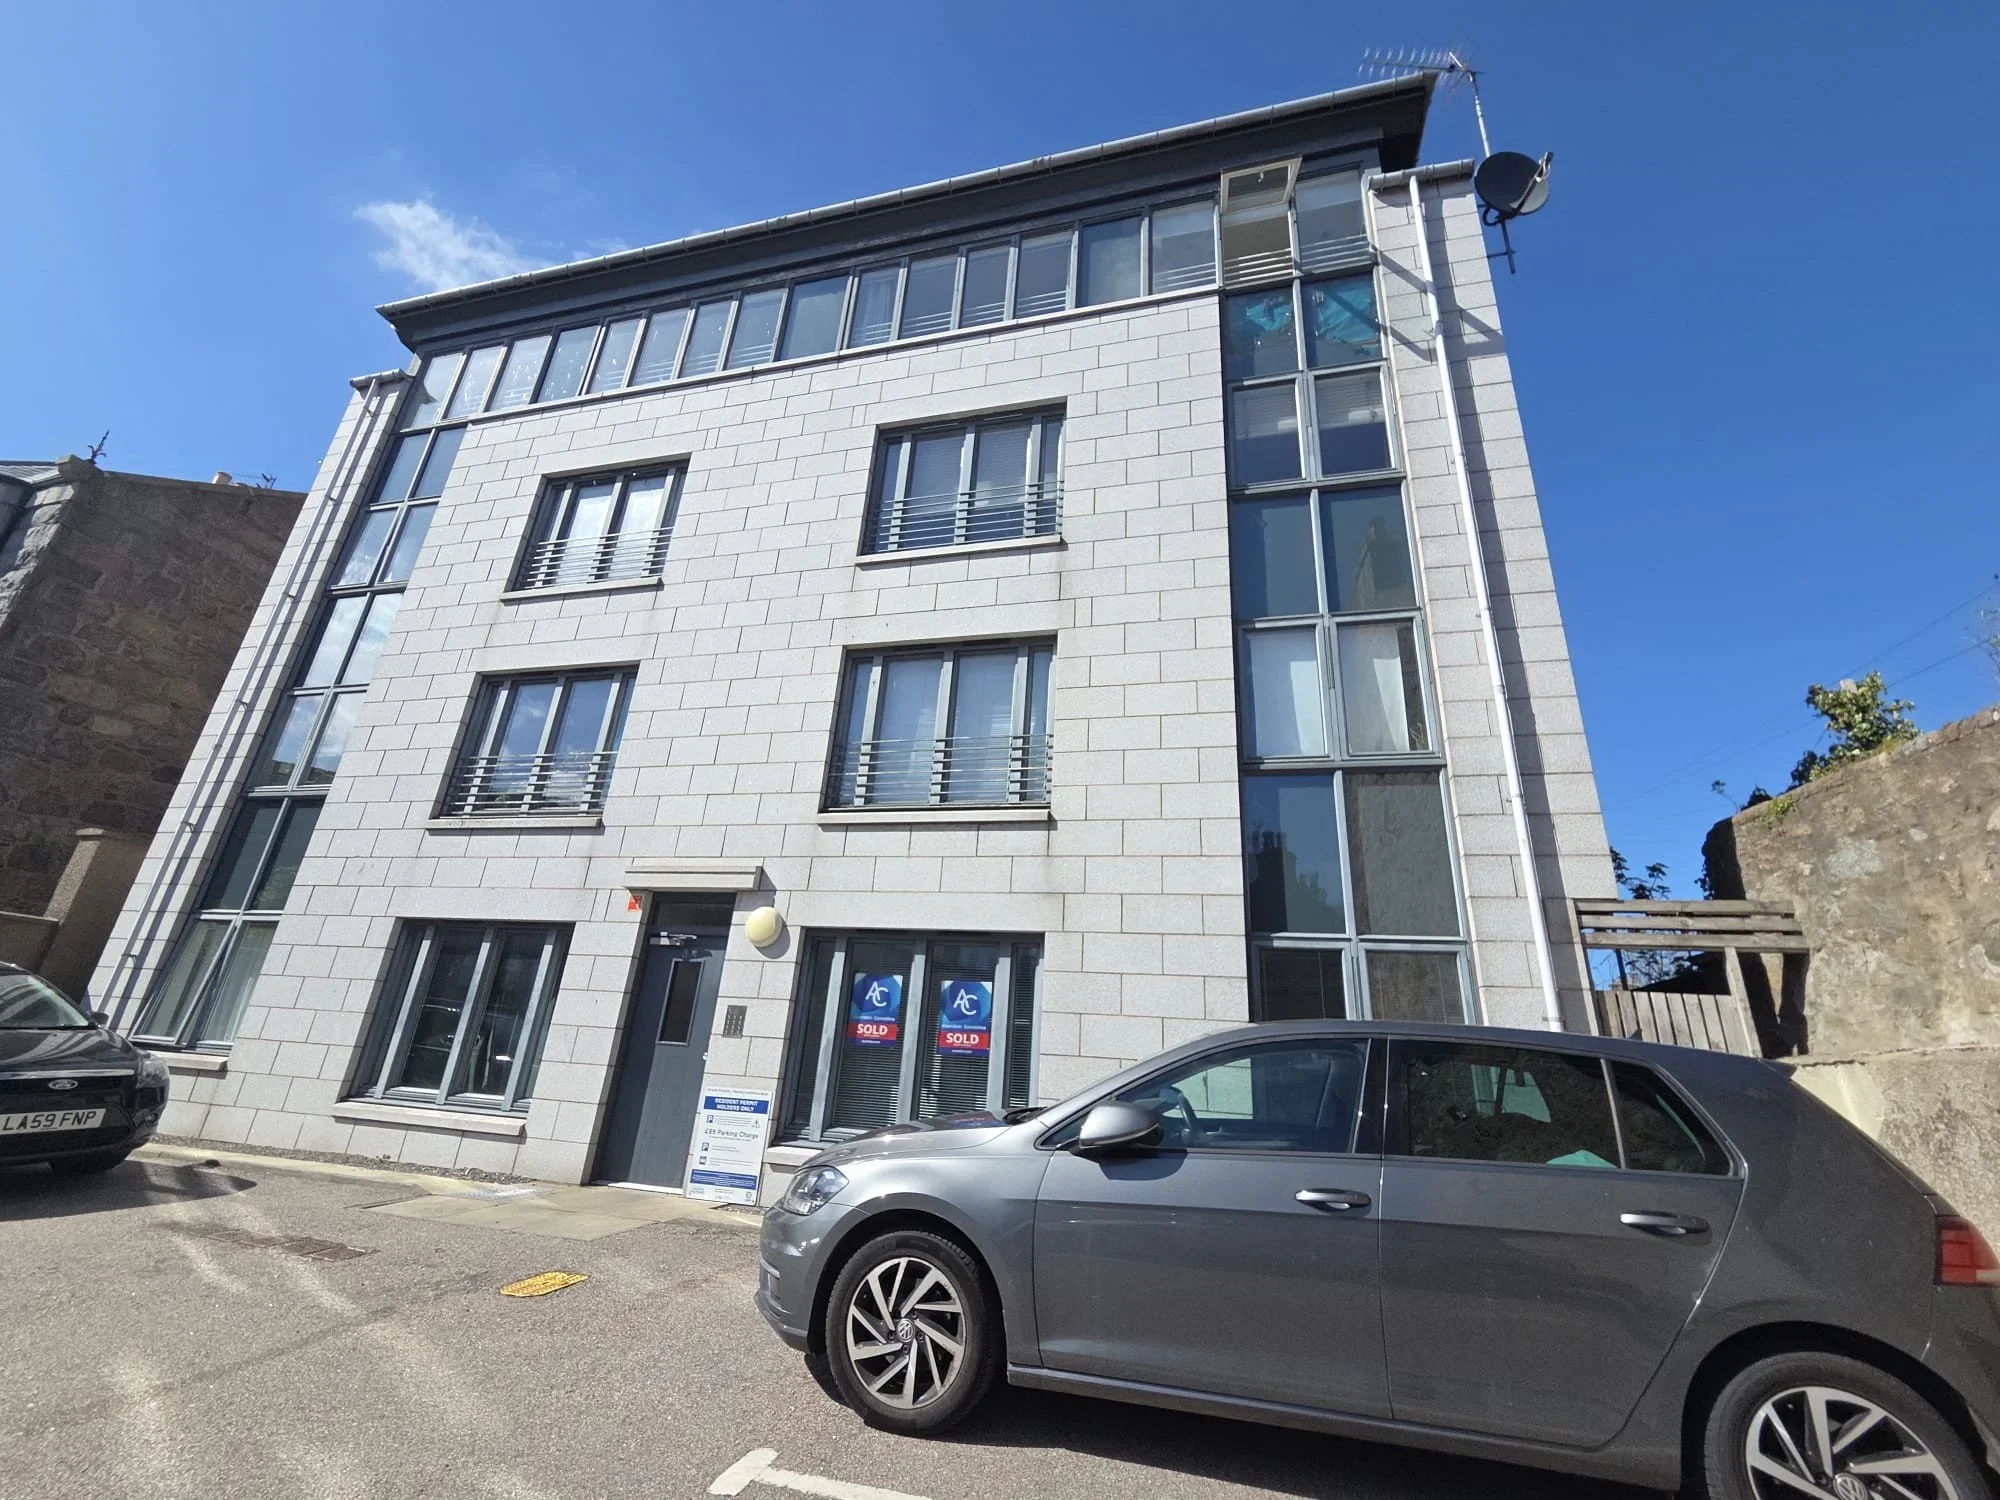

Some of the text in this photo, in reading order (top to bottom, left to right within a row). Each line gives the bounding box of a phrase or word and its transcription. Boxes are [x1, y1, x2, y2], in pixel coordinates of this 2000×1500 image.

[856, 1023, 888, 1036] SOLD
[946, 1032, 980, 1045] SOLD
[2, 1110, 97, 1131] LA59 FNP
[717, 1129, 738, 1138] Parking
[739, 1131, 759, 1140] Charge
